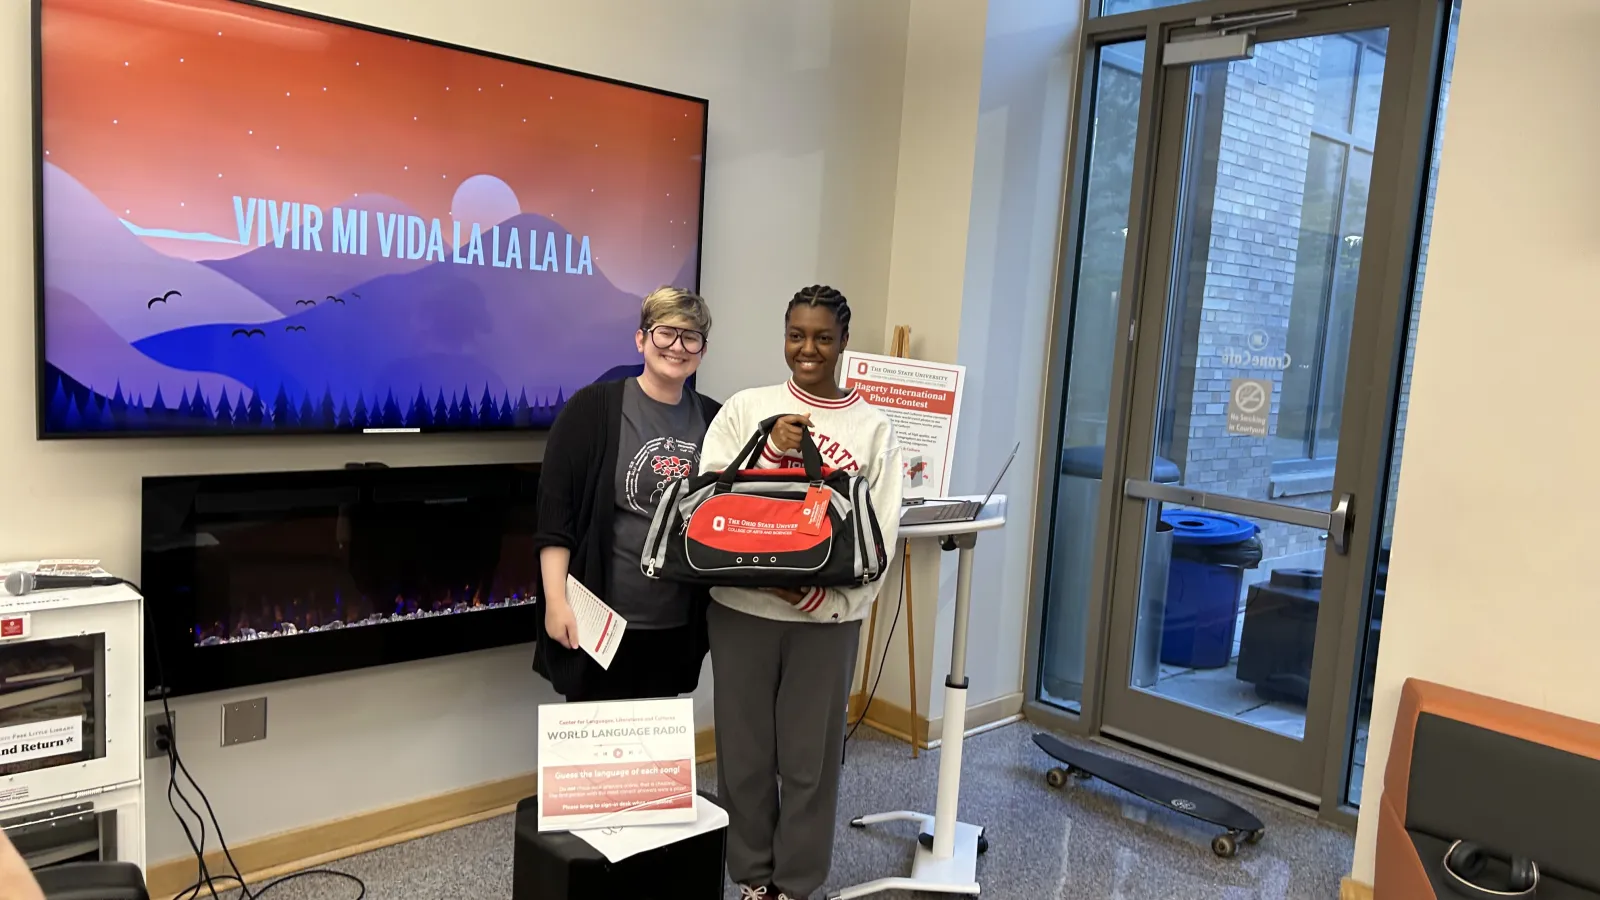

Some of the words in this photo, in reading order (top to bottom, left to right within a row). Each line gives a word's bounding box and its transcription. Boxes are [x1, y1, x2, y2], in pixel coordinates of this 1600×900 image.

[232, 196, 323, 252] VIVIR
[332, 207, 368, 256] MI
[376, 212, 446, 263] VIDA
[453, 220, 484, 266] LA
[492, 225, 522, 270] LA
[529, 230, 558, 272] LA
[564, 234, 593, 276] LA
[915, 372, 948, 381] UNIVERSITY
[854, 382, 888, 395] Hagerty
[890, 386, 946, 401] International
[870, 394, 894, 404] Photo
[896, 397, 928, 408] Contest
[1240, 412, 1266, 426] Smoking
[1236, 423, 1265, 434] Courtyard
[810, 431, 859, 472] TATE
[547, 730, 588, 740] WORLD
[592, 727, 650, 738] LANGUAGE
[653, 726, 686, 735] RADIO
[0, 744, 17, 756] nd
[21, 740, 64, 752] Return
[555, 772, 578, 780] Guess
[594, 768, 629, 779] language
[631, 767, 639, 775] of
[641, 766, 658, 775] each
[660, 766, 680, 775] song!
